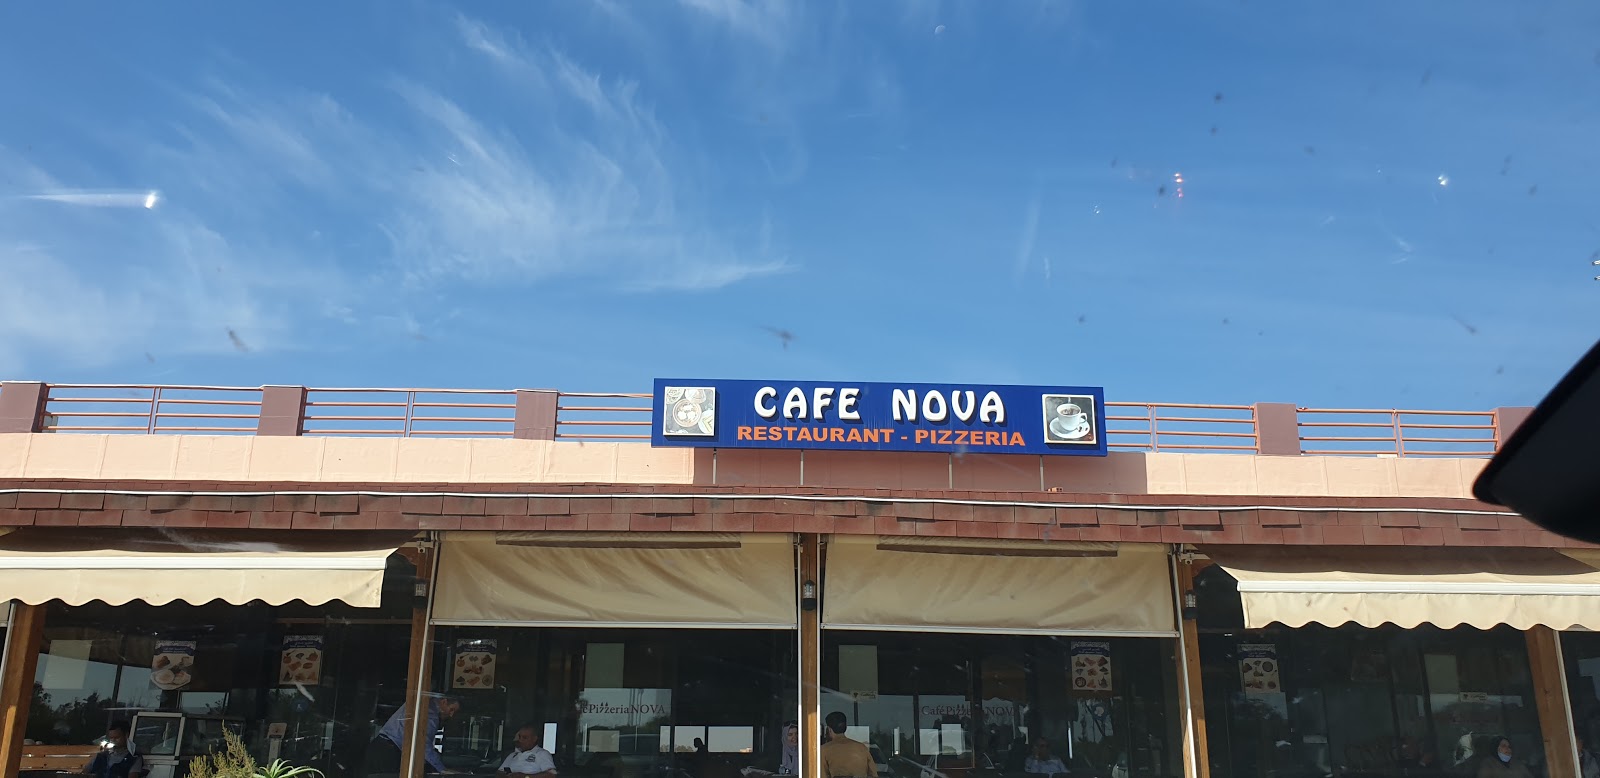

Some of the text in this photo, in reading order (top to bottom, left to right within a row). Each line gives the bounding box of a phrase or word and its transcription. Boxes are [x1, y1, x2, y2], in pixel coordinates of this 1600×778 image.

[753, 386, 1006, 424] CAFE NOVA
[736, 426, 894, 444] RESTAURANT
[914, 429, 1026, 447] PIZZERIA
